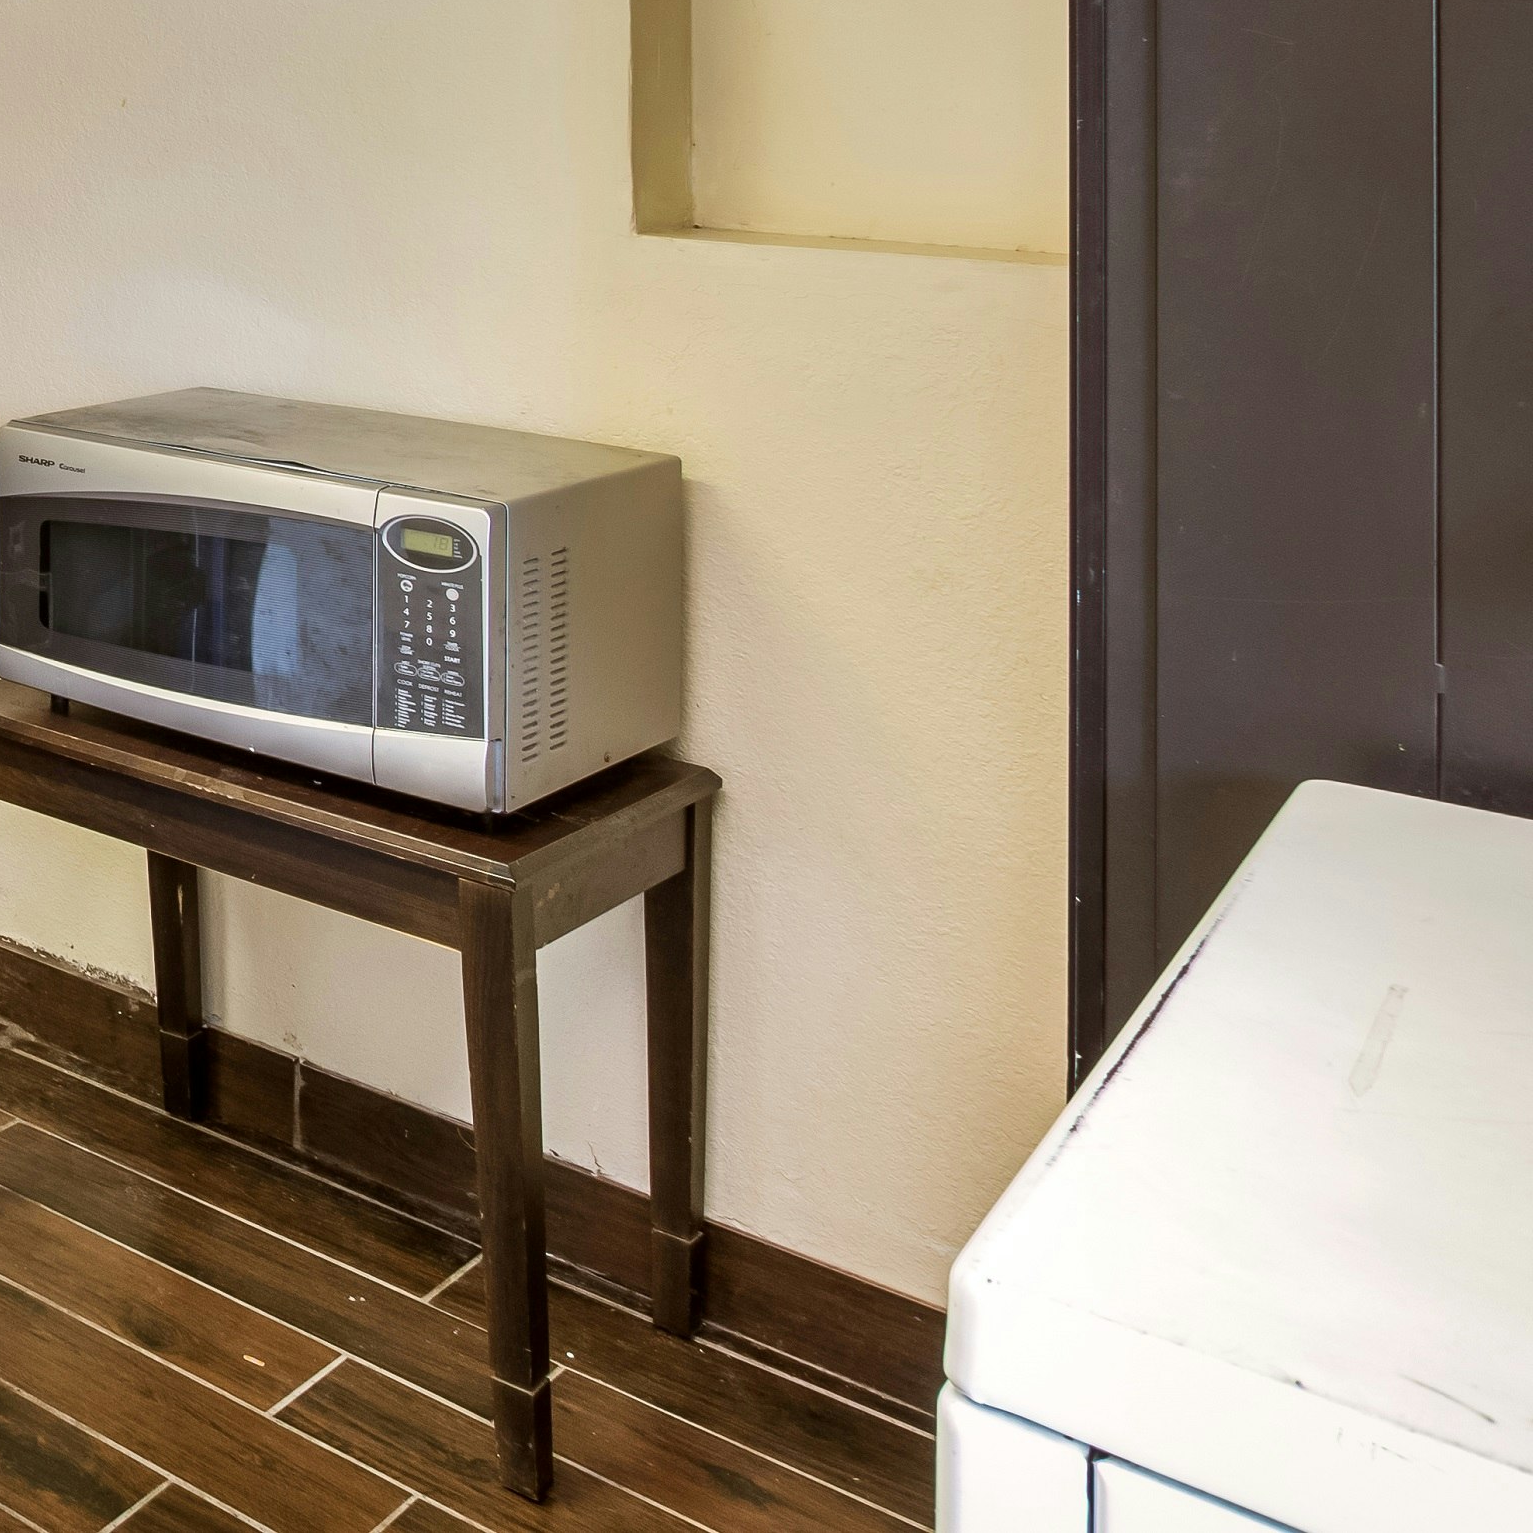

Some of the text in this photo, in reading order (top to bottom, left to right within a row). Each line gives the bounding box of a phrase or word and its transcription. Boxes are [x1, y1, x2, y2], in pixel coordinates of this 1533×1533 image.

[18, 455, 86, 474] SHARP Carousel
[404, 595, 409, 603] 1
[426, 599, 433, 608] 2
[403, 608, 410, 616] 4
[450, 604, 456, 613] 3
[426, 612, 433, 621] 5
[449, 616, 456, 625] 6
[404, 620, 410, 628] 7
[426, 624, 433, 633] 8
[449, 629, 456, 638] 9
[426, 637, 433, 646] 0
[444, 655, 461, 664] START
[397, 678, 413, 686] COOK
[418, 683, 440, 692] DEFROST
